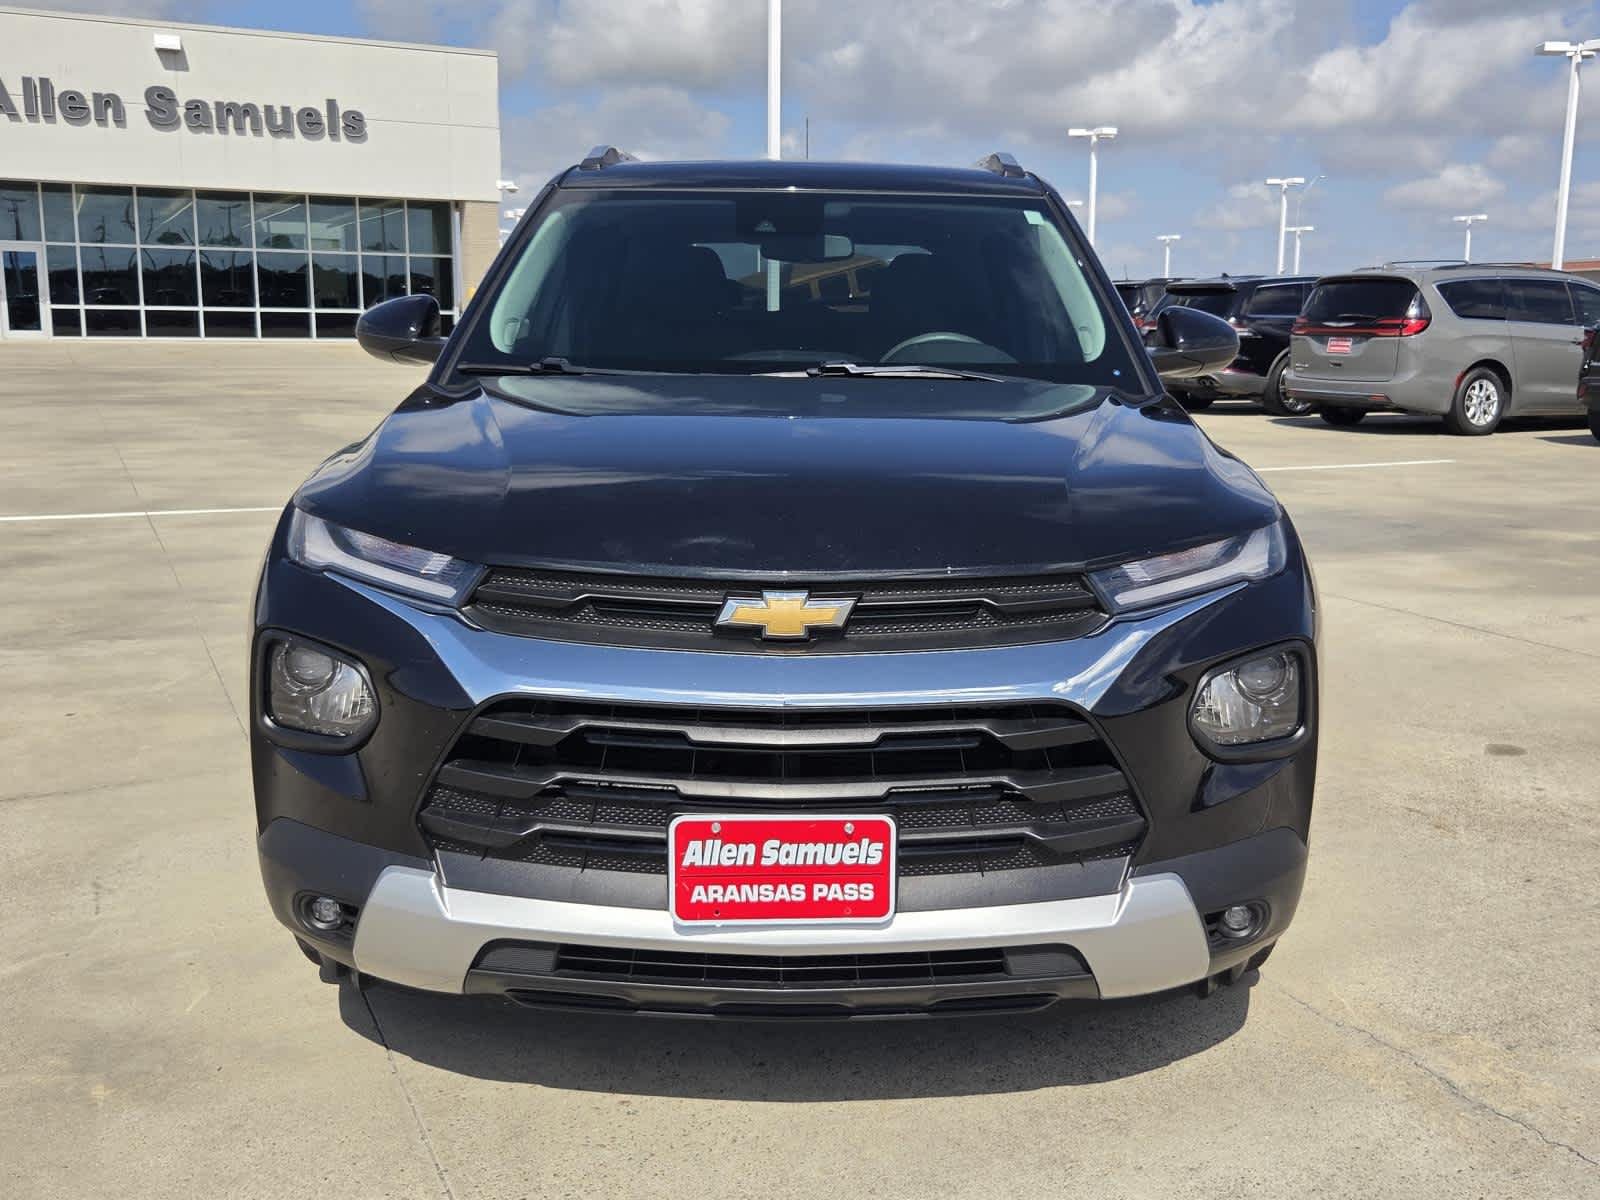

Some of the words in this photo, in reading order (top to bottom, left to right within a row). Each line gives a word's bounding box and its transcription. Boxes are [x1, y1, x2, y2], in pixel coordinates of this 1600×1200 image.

[144, 85, 367, 144] Samuels
[681, 839, 756, 867] Allen
[760, 837, 884, 866] Samuels
[690, 884, 806, 904] ARANSAS
[812, 883, 875, 902] PASS
